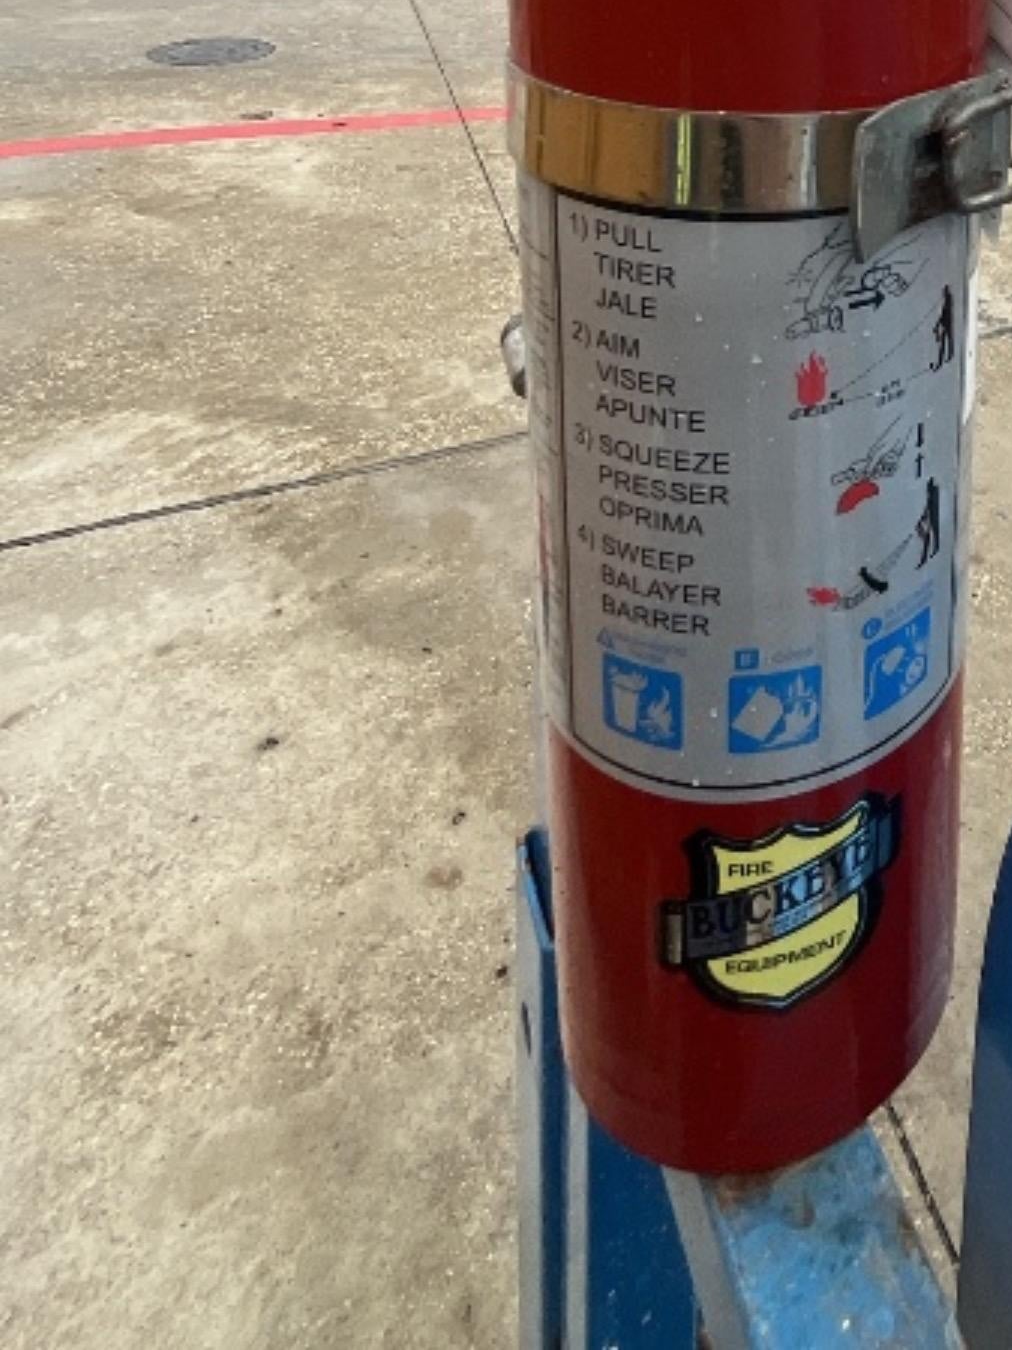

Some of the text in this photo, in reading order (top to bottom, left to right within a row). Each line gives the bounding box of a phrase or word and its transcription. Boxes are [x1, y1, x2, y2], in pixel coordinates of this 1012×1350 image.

[570, 211, 663, 253] 1) PULL
[593, 251, 676, 289] TIRER
[596, 287, 657, 319] JALE
[571, 319, 640, 359] 2) AIM
[596, 359, 676, 397] VISER
[595, 394, 706, 433] APUNTE
[599, 434, 730, 475] SQUEEZE
[598, 464, 729, 505] PRESSER
[599, 497, 704, 536] OPRIMA
[602, 533, 695, 573] SWEEP
[601, 563, 722, 607] BALAYER
[602, 593, 711, 637] BARRER
[692, 835, 873, 941] BUCKEYE
[728, 860, 774, 878] FIRE
[724, 929, 848, 975] EQUIPMENT
